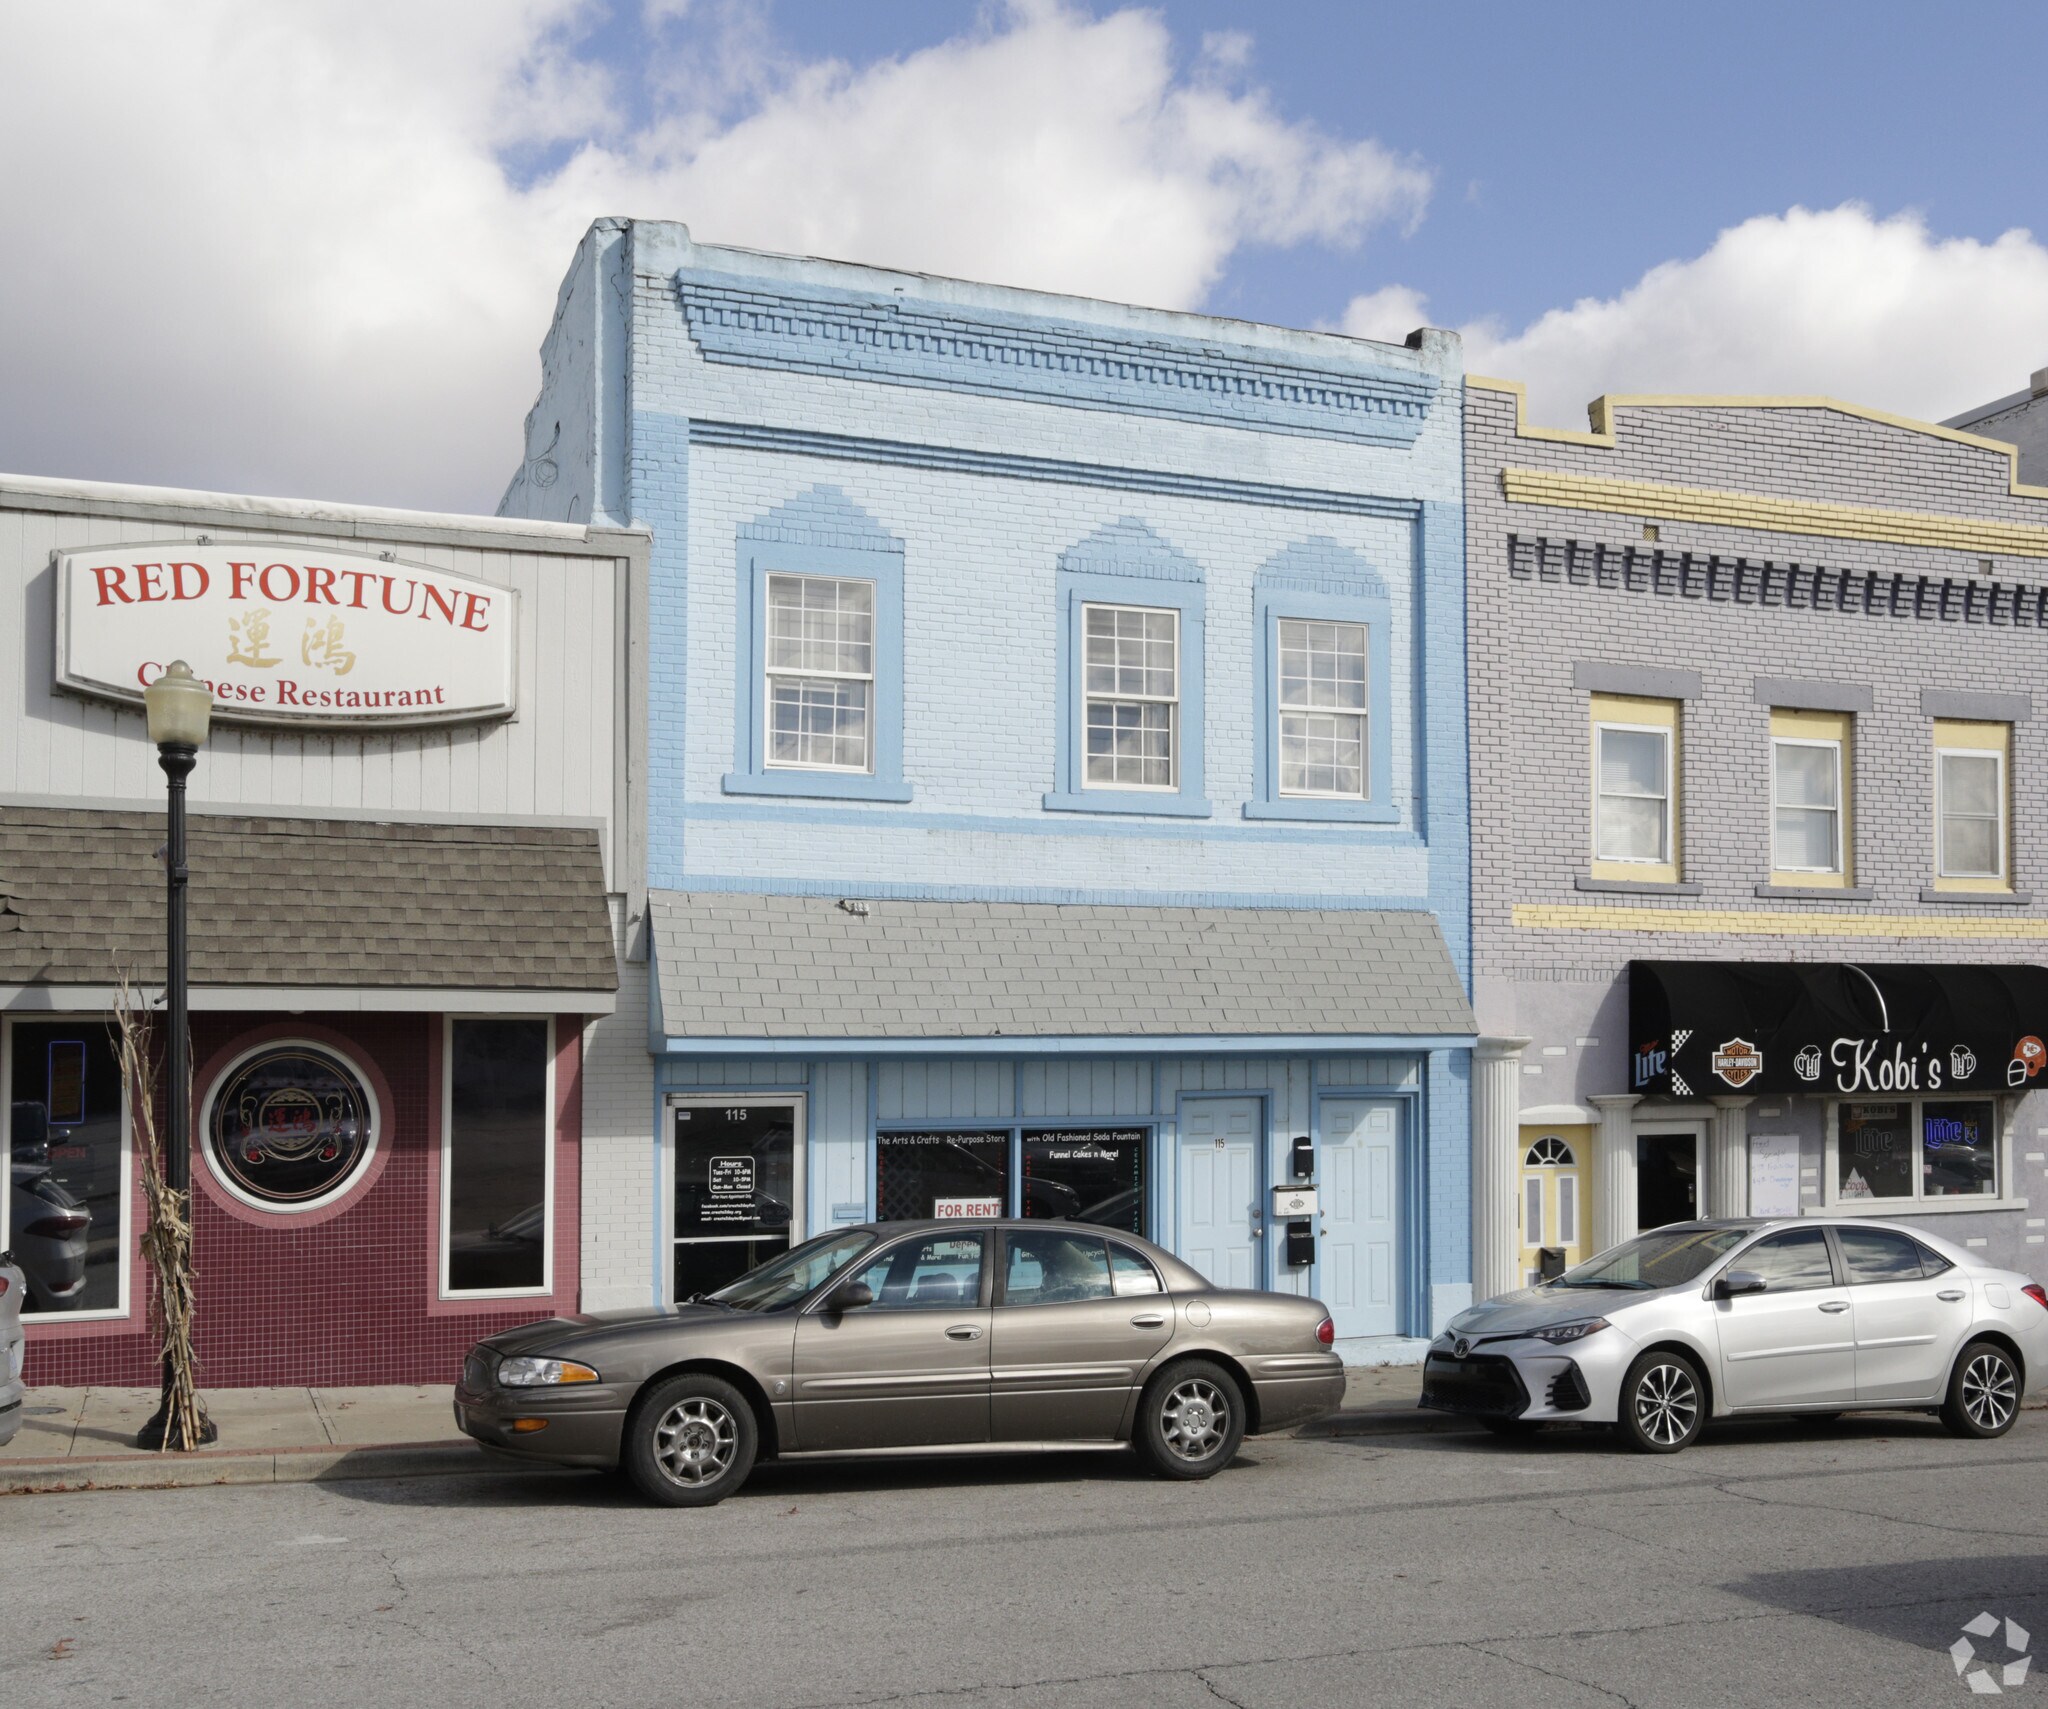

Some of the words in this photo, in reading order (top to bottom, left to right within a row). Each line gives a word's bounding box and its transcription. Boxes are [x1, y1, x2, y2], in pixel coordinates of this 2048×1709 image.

[89, 562, 210, 606] RED
[226, 562, 491, 632] FORTUNE
[137, 661, 266, 703] Cnese
[276, 679, 446, 707] Restaurant
[1727, 1047, 1748, 1056] MOTOR
[1635, 1050, 1667, 1087] Lite
[1717, 1057, 1758, 1068] HARLEY-DAVIDSON
[1830, 1037, 1942, 1093] Kobi's
[1726, 1069, 1748, 1081] CYCLES
[725, 1109, 747, 1120] 115
[1042, 1133, 1055, 1142] Old
[1057, 1132, 1091, 1142] Fashioned
[1093, 1133, 1110, 1141] Soda
[1112, 1132, 1141, 1140] Fountain
[1925, 1118, 1962, 1150] Lite
[877, 1136, 890, 1145] The
[892, 1136, 909, 1145] Arts
[909, 1136, 915, 1144] &
[917, 1135, 940, 1144] Crafts
[946, 1135, 984, 1146] Re-Purpose
[986, 1135, 1006, 1143] Store
[1214, 1138, 1225, 1149] 115
[1854, 1127, 1893, 1159] Lite
[1049, 1150, 1071, 1159] Funnel
[1072, 1150, 1092, 1158] Cakes
[1100, 1149, 1119, 1158] More!
[937, 1204, 962, 1217] FOR
[966, 1203, 999, 1217] RENT
